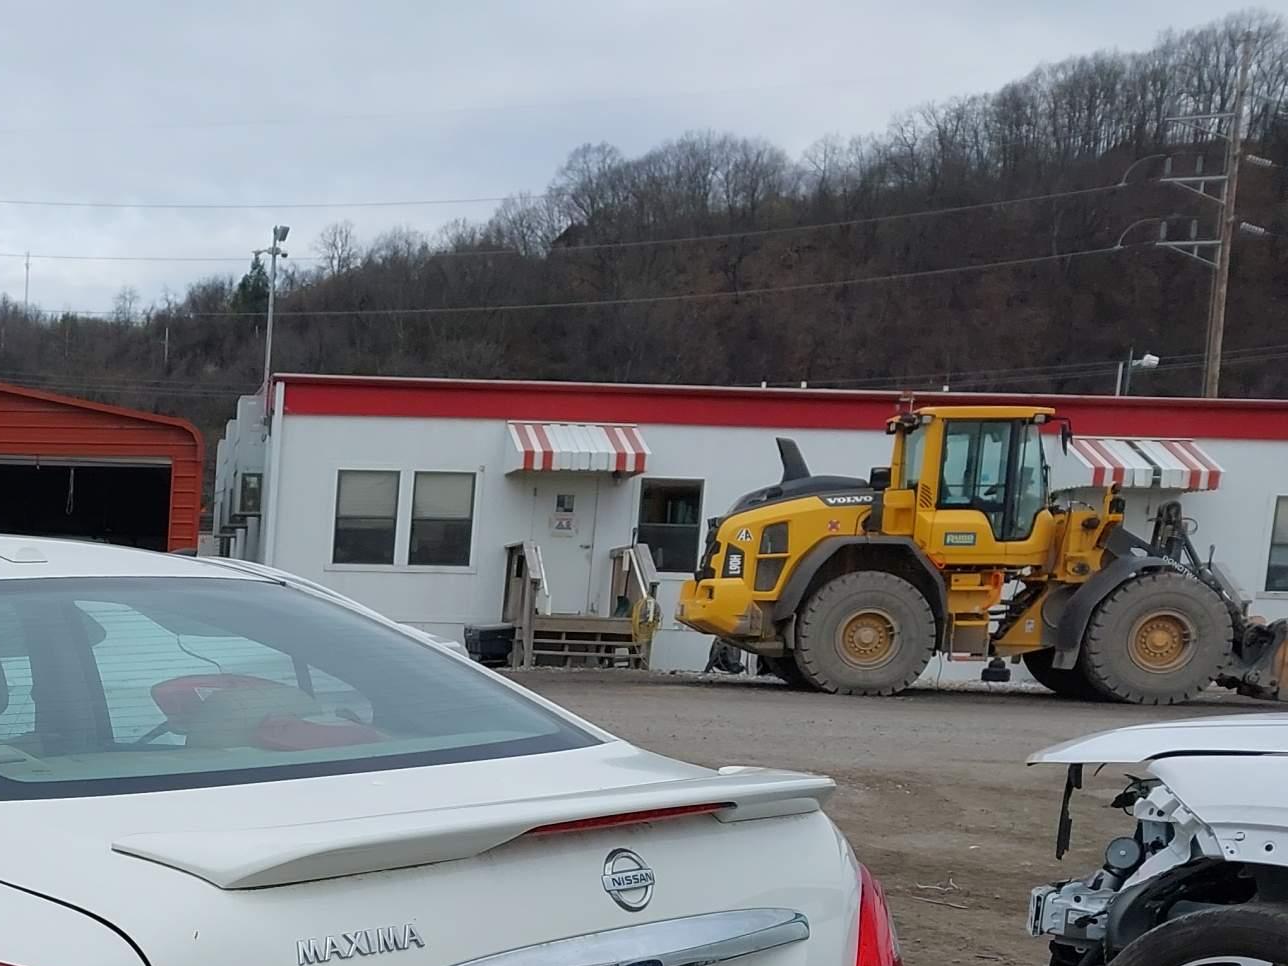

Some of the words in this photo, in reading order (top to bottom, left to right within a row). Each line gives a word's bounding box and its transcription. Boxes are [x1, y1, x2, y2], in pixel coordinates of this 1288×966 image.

[826, 495, 873, 504] VOLVO
[729, 554, 743, 575] L90H
[611, 872, 652, 887] NISSAN
[296, 923, 425, 966] MAXIMA
